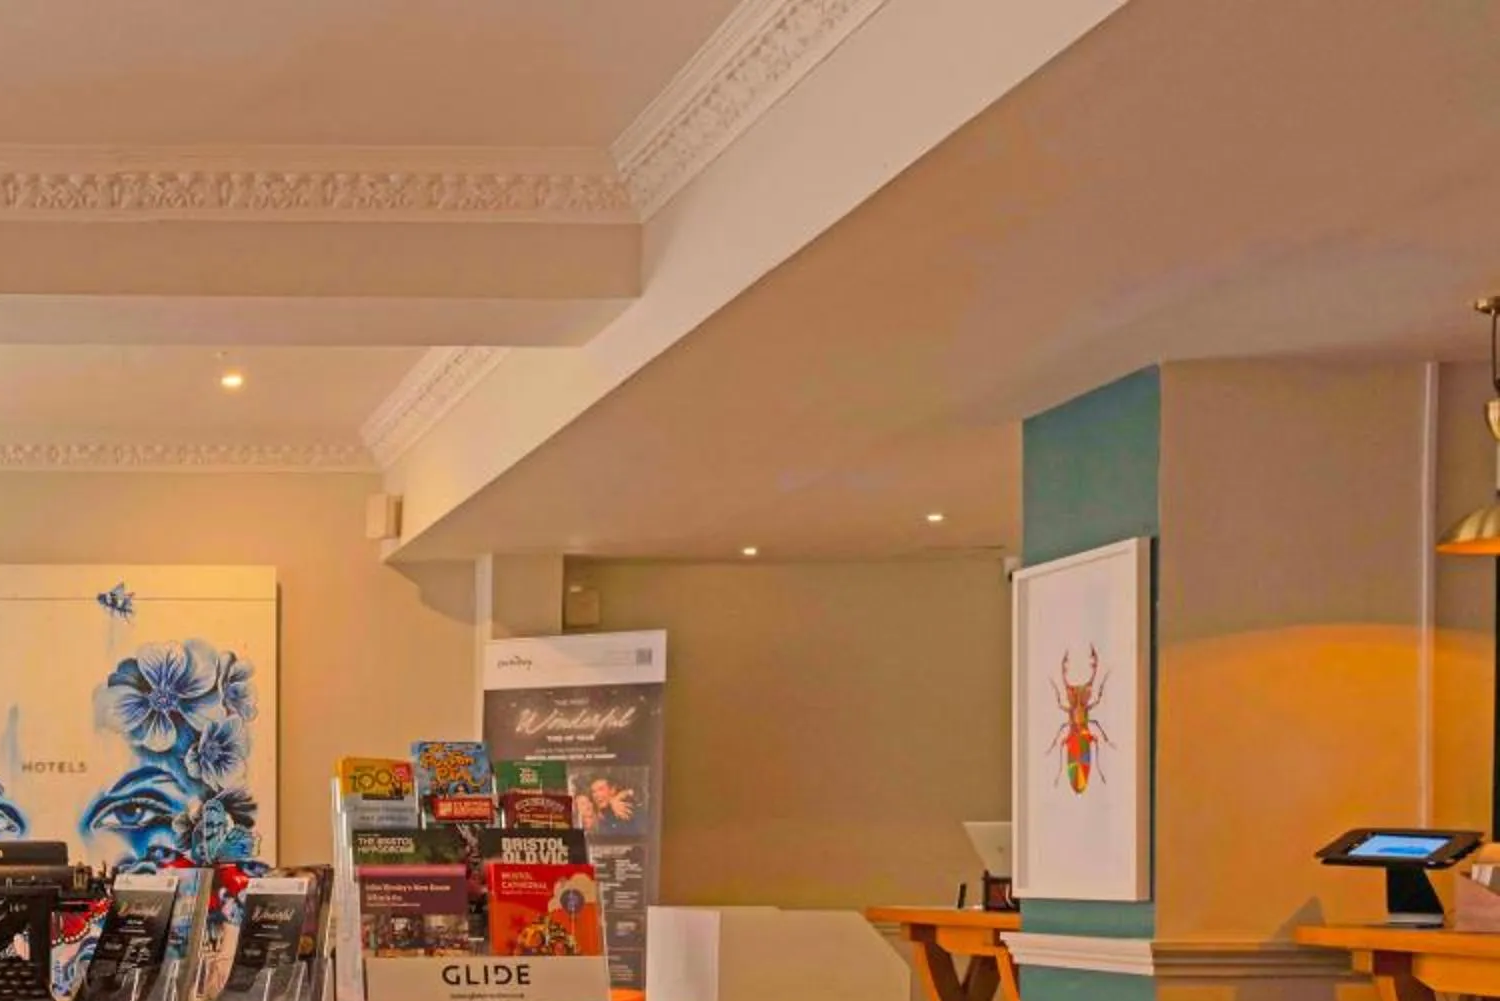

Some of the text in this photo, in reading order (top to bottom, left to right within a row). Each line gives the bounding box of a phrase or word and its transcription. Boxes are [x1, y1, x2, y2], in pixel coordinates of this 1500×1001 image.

[515, 706, 636, 735] Wonderful
[21, 761, 88, 774] HOTELS
[501, 837, 569, 851] BRISTOL
[502, 851, 569, 865] OLD VIC
[441, 964, 532, 985] GLIDE
